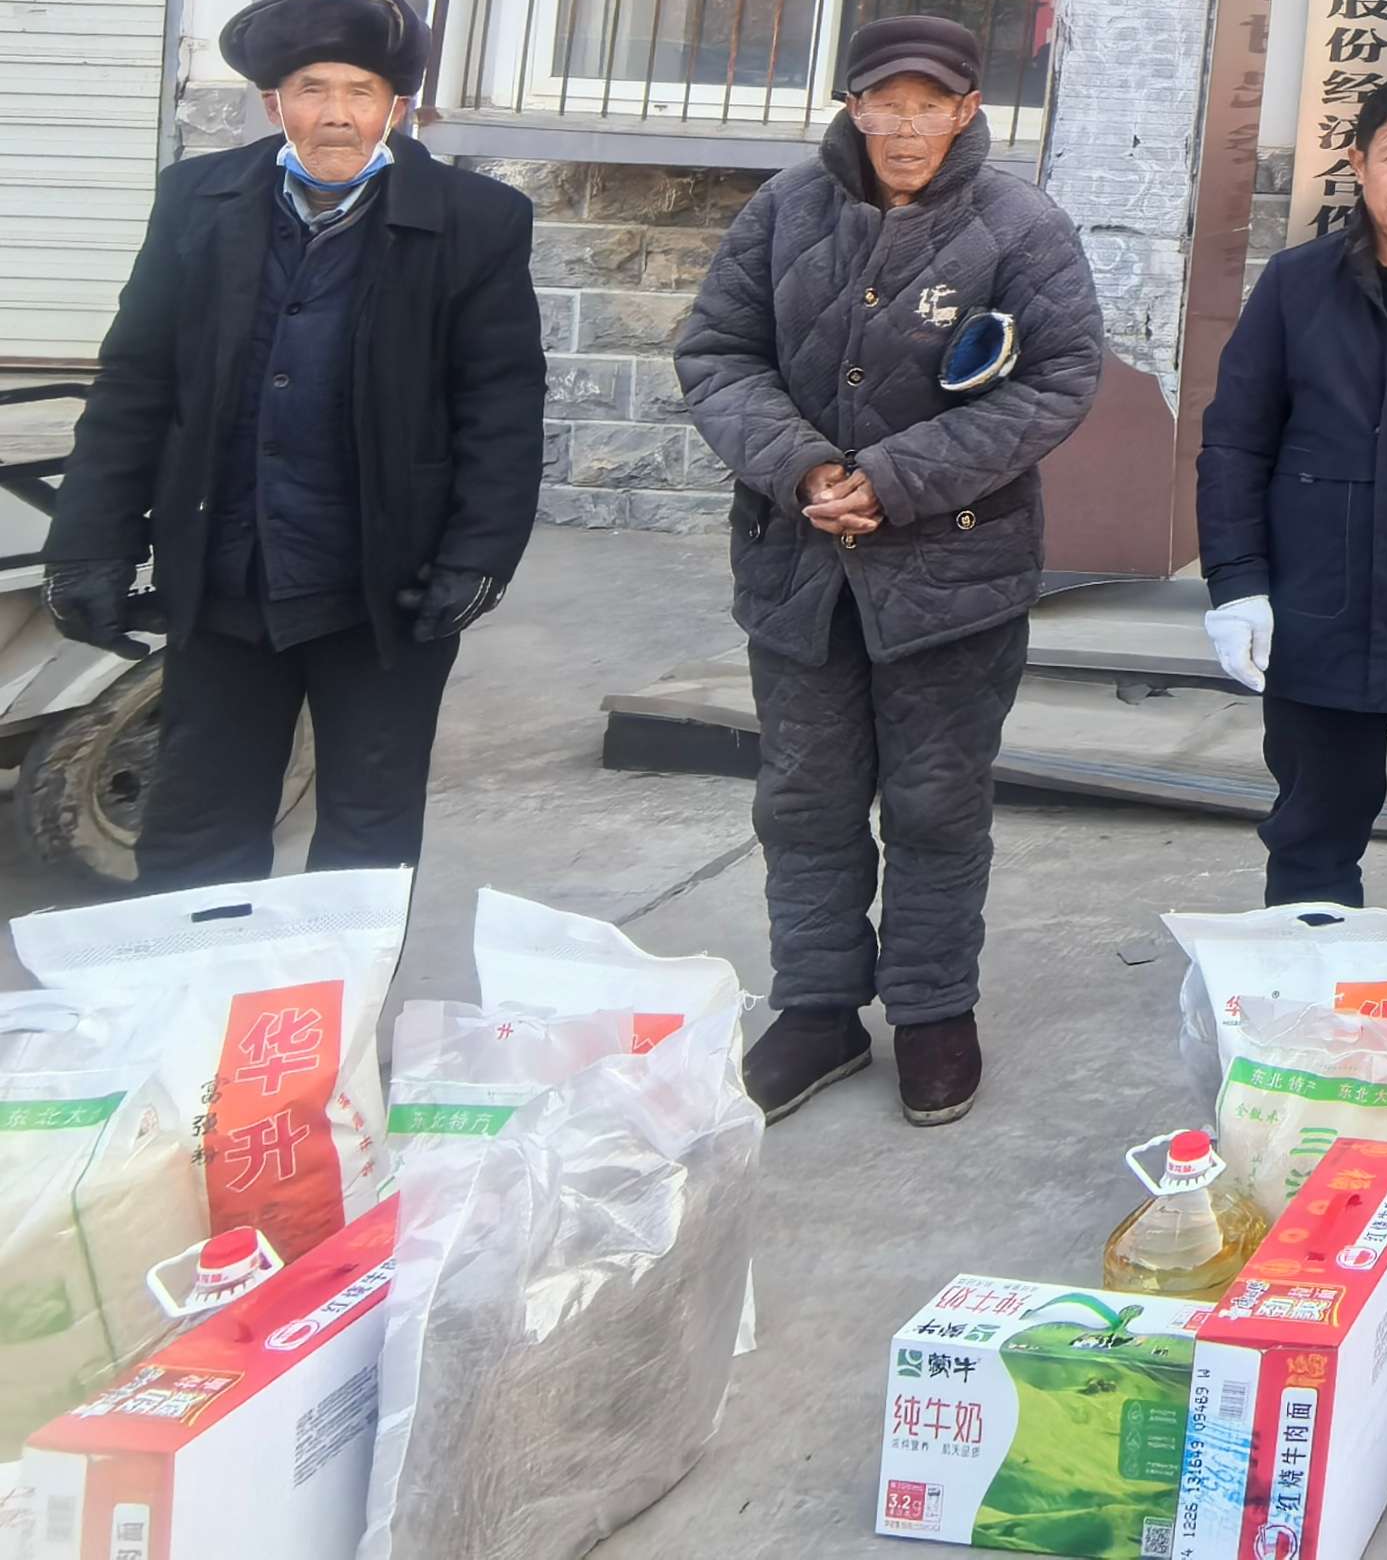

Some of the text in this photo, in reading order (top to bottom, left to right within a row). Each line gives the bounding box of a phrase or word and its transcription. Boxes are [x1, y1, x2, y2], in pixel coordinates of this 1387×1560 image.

[226, 1008, 323, 1192] 华升
[928, 1352, 977, 1383] 蒙牛
[893, 1395, 983, 1444] 纯牛奶
[1275, 1401, 1313, 1512] 红烧牛肉面
